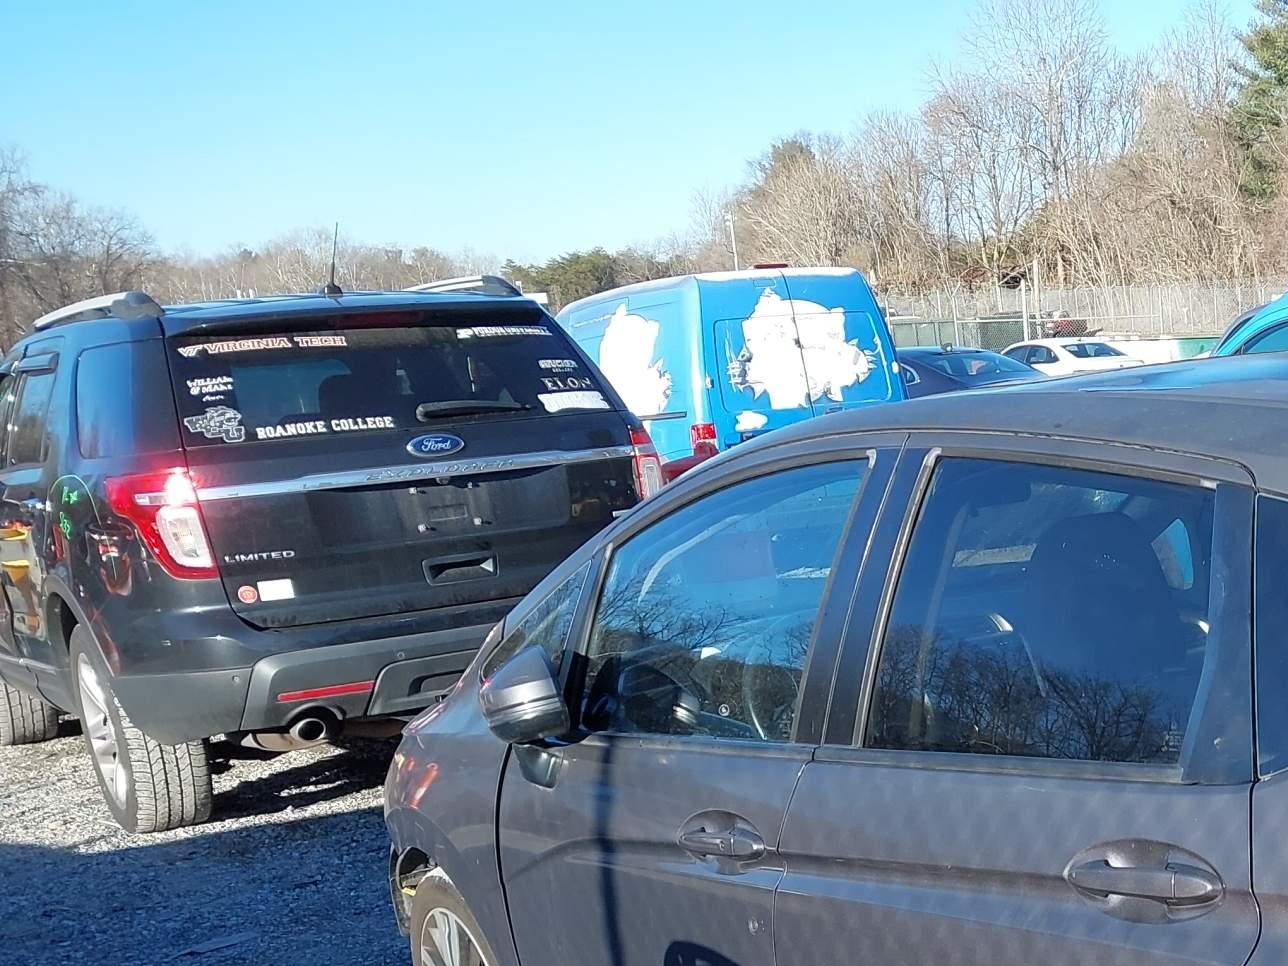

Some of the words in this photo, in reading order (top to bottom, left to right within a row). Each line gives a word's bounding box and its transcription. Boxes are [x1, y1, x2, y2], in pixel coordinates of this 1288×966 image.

[202, 337, 292, 354] VIRGINIA
[293, 336, 347, 347] TECH
[540, 377, 593, 390] ELON
[256, 421, 327, 440] ROANOKE
[331, 416, 395, 431] COLLEGE
[421, 437, 451, 452] Ford
[224, 550, 296, 563] LIMITED
